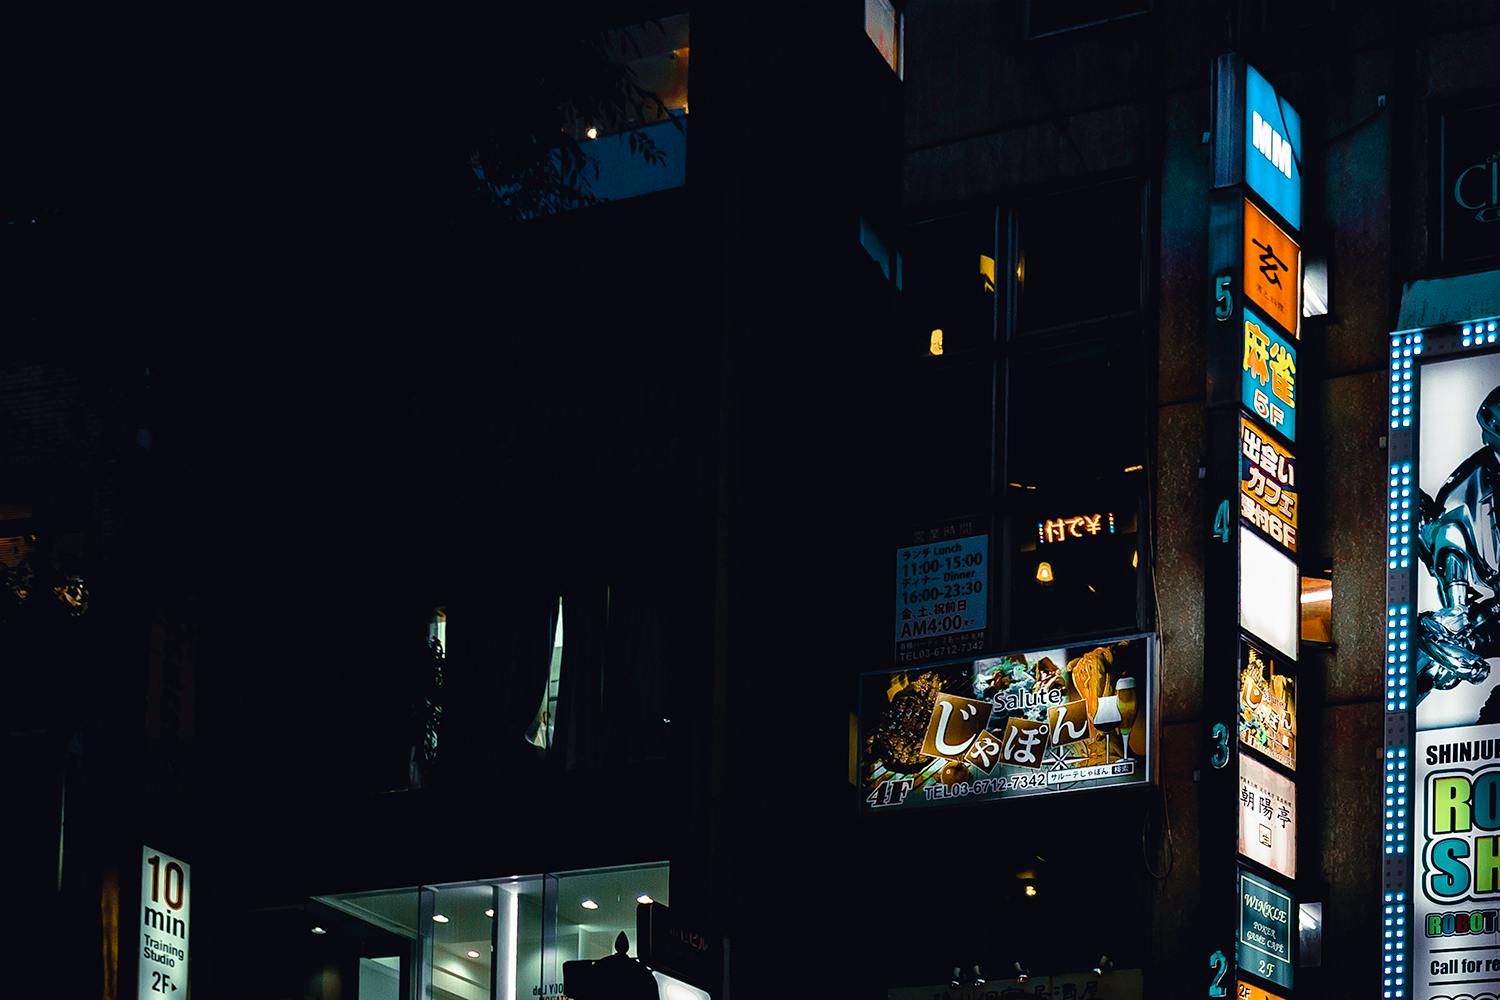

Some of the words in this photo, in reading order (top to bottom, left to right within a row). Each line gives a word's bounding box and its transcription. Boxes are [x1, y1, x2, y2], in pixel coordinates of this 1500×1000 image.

[1215, 275, 1234, 322] 5
[1242, 428, 1296, 487] 出会い
[1247, 468, 1294, 519] カフェ
[1211, 499, 1231, 544] 4
[933, 542, 962, 557] Lunch
[903, 552, 984, 578] 11:00-15:00
[943, 570, 976, 583] Dinner
[902, 580, 983, 606] 16:00-23:30
[902, 614, 963, 639] AM4:00
[993, 686, 1064, 712] Salute
[1209, 721, 1231, 769] 3
[867, 778, 914, 809] 4F
[924, 774, 1046, 801] TEL03-6712-7342
[148, 855, 185, 911] 10
[144, 905, 186, 940] min
[1426, 911, 1497, 937] ROBOT
[143, 933, 185, 961] Training
[143, 947, 175, 969] Studio
[1208, 949, 1229, 998] 2
[1430, 956, 1458, 976] Call
[1461, 956, 1483, 975] for
[151, 970, 170, 994] 2F
[1238, 984, 1251, 1000] 2F
